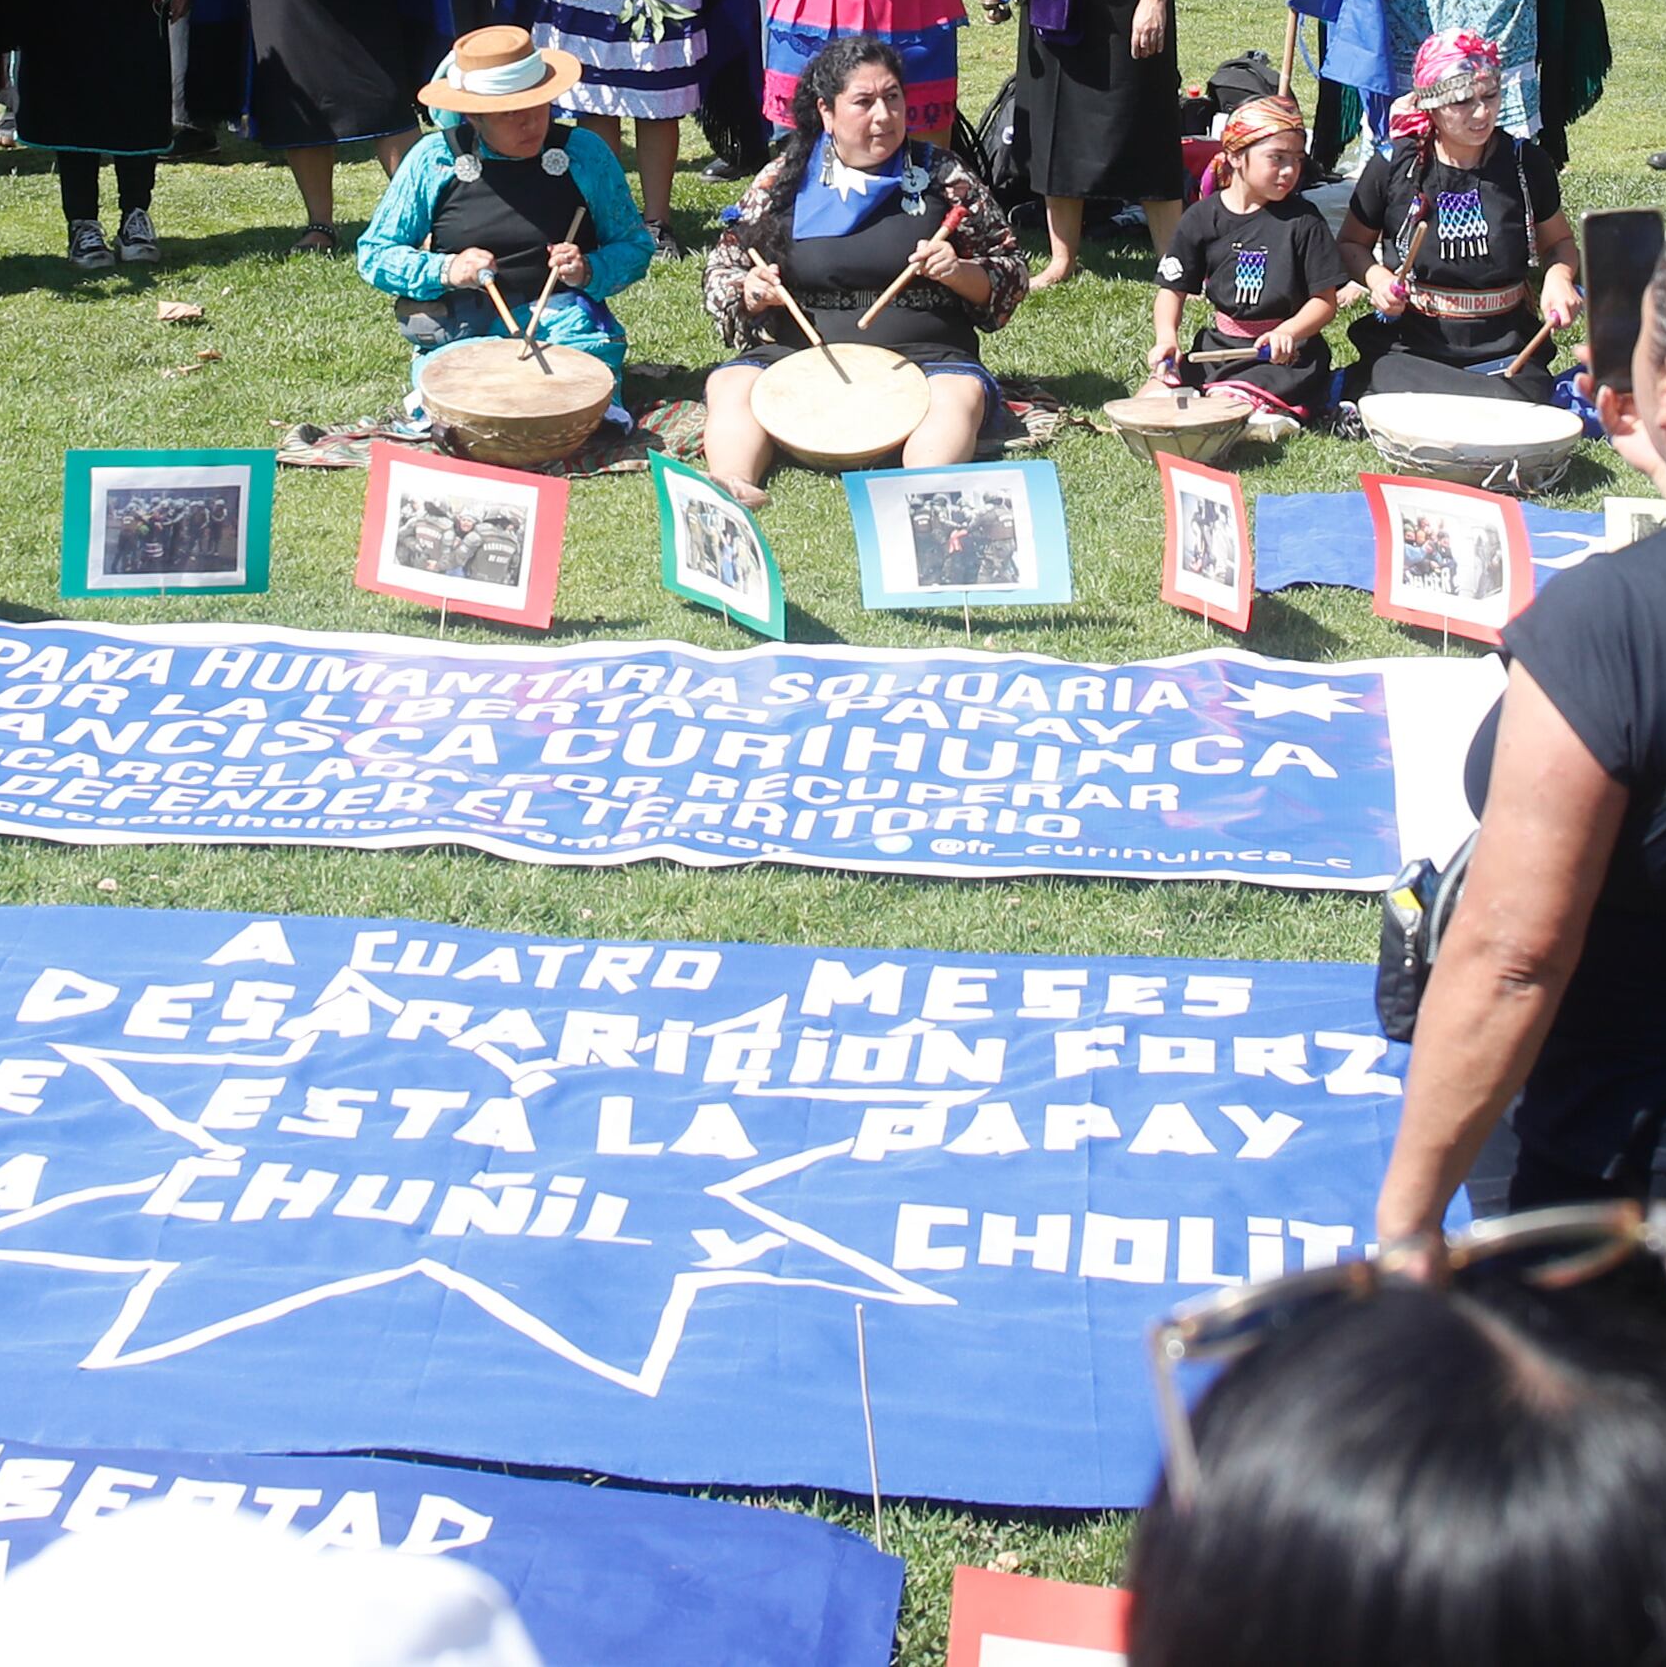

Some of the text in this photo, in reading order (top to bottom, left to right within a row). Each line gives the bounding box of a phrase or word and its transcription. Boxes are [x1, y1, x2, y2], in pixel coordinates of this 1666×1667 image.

[191, 647, 738, 703] HUMANITARIA
[762, 672, 1190, 715] SOLIDARIA
[150, 693, 269, 720] LA
[301, 694, 769, 725] LIBERTAD
[826, 695, 1142, 745] PAPAY
[540, 721, 1339, 782] CURIHUINCA
[452, 789, 548, 827] EL
[578, 795, 1082, 842] TERRITORIO
[497, 773, 662, 798] POR
[687, 771, 1180, 812] RECUPERAR
[202, 920, 1253, 1020] A CUATRO MESES
[595, 1096, 760, 1160] LA
[851, 1101, 1303, 1162] PAPAY
